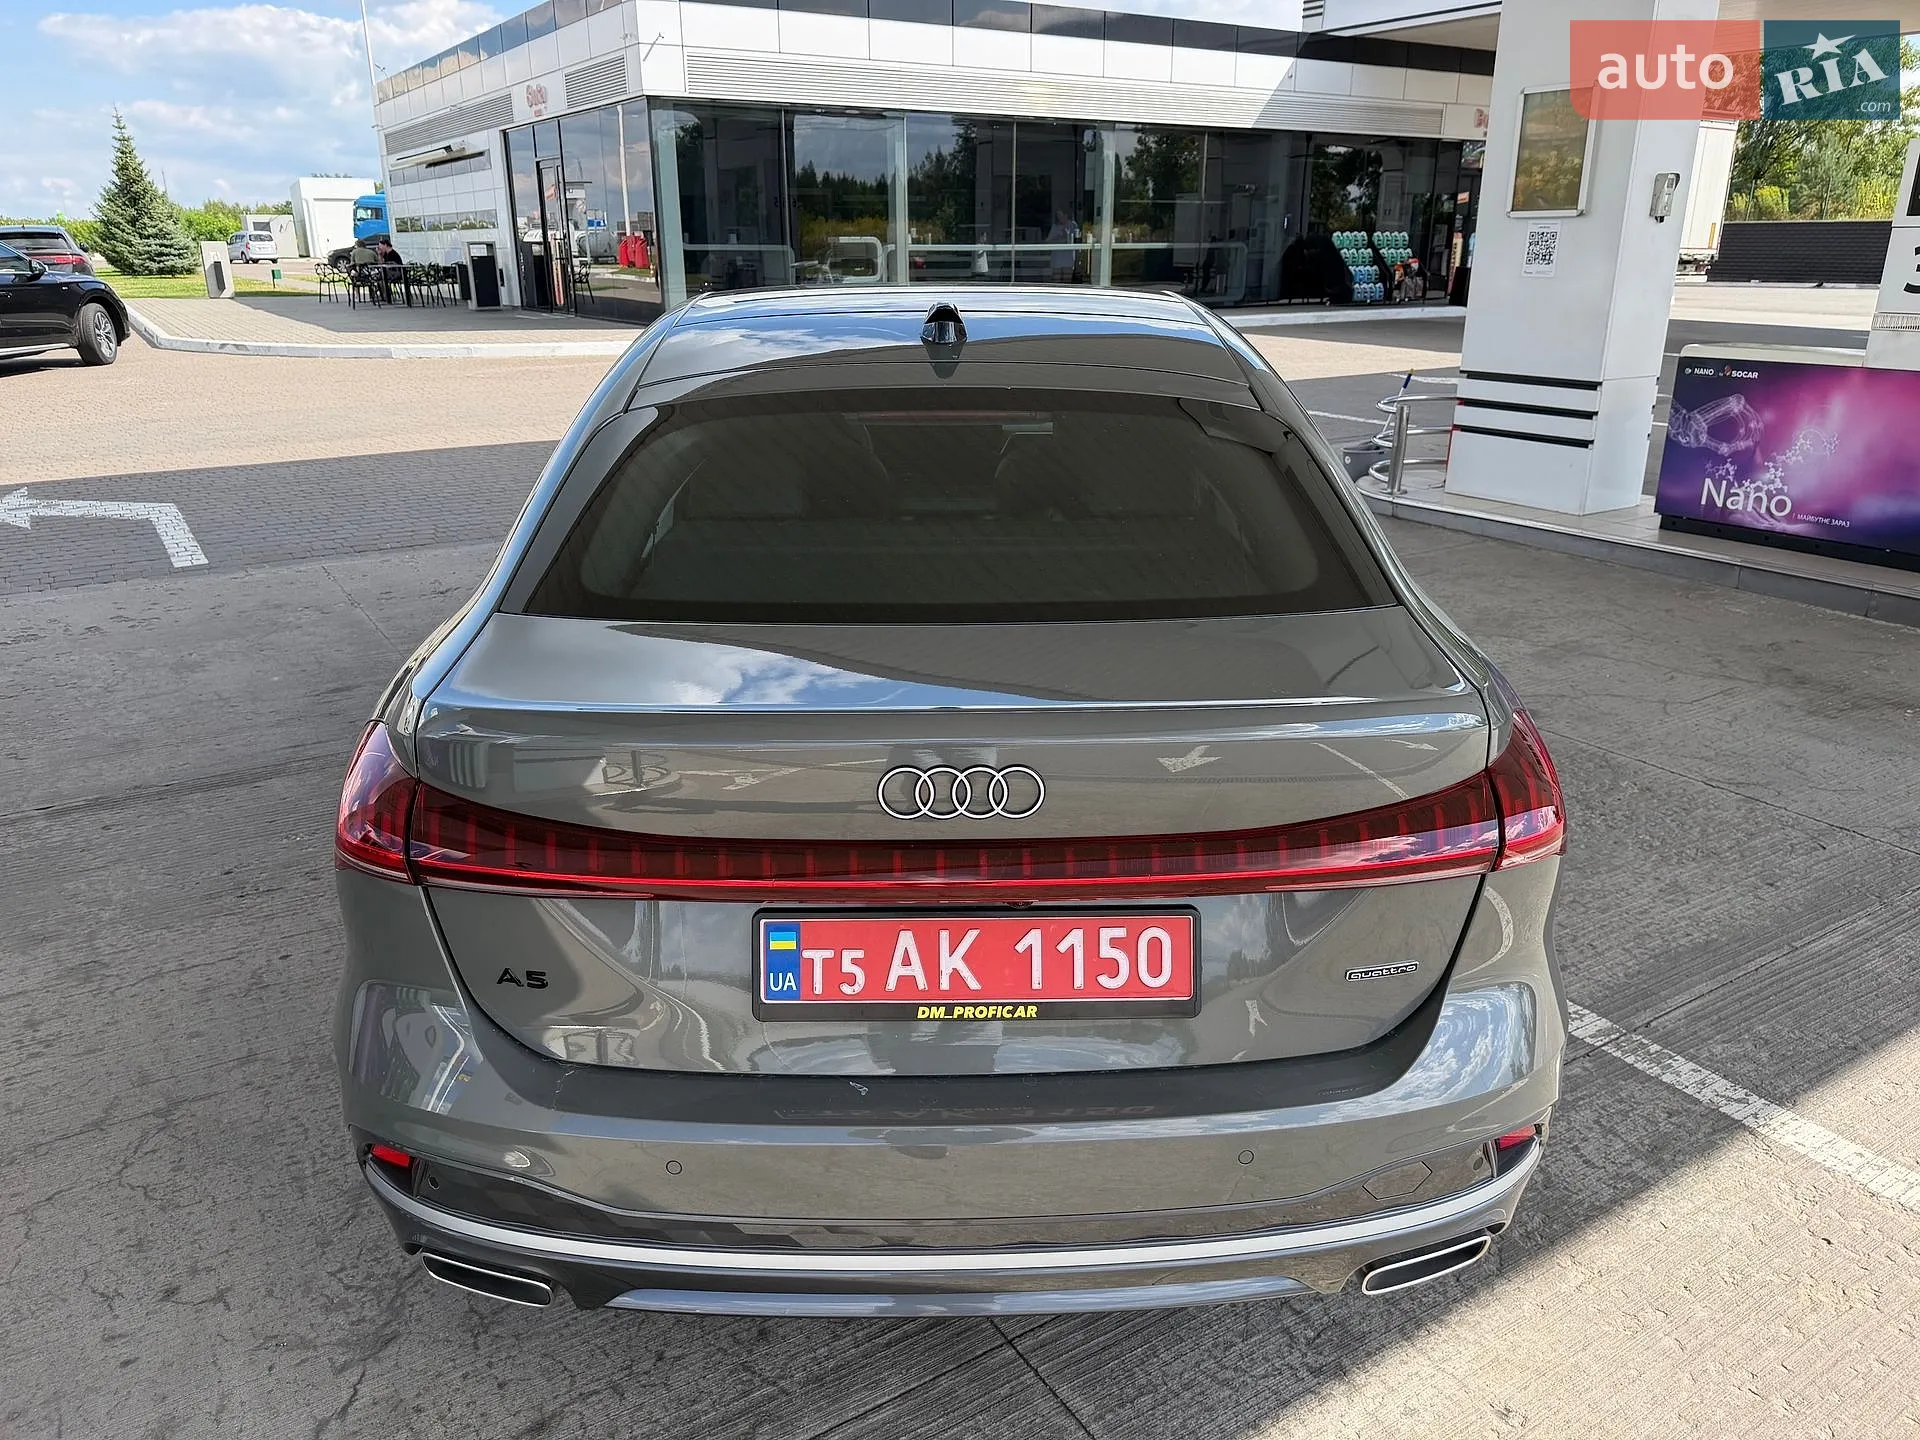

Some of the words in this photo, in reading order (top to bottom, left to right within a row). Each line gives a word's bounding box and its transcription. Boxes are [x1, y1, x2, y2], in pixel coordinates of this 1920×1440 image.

[1694, 367, 1714, 376] NANO
[1731, 370, 1759, 379] SOCAR
[1700, 477, 1792, 517] Nano
[802, 949, 866, 995] T5
[885, 929, 982, 992] AK
[1014, 926, 1172, 990] 1150
[496, 967, 549, 989] A5
[769, 972, 797, 991] UA
[1350, 965, 1416, 980] quattro
[916, 1006, 1036, 1020] DM_PROFICAR
